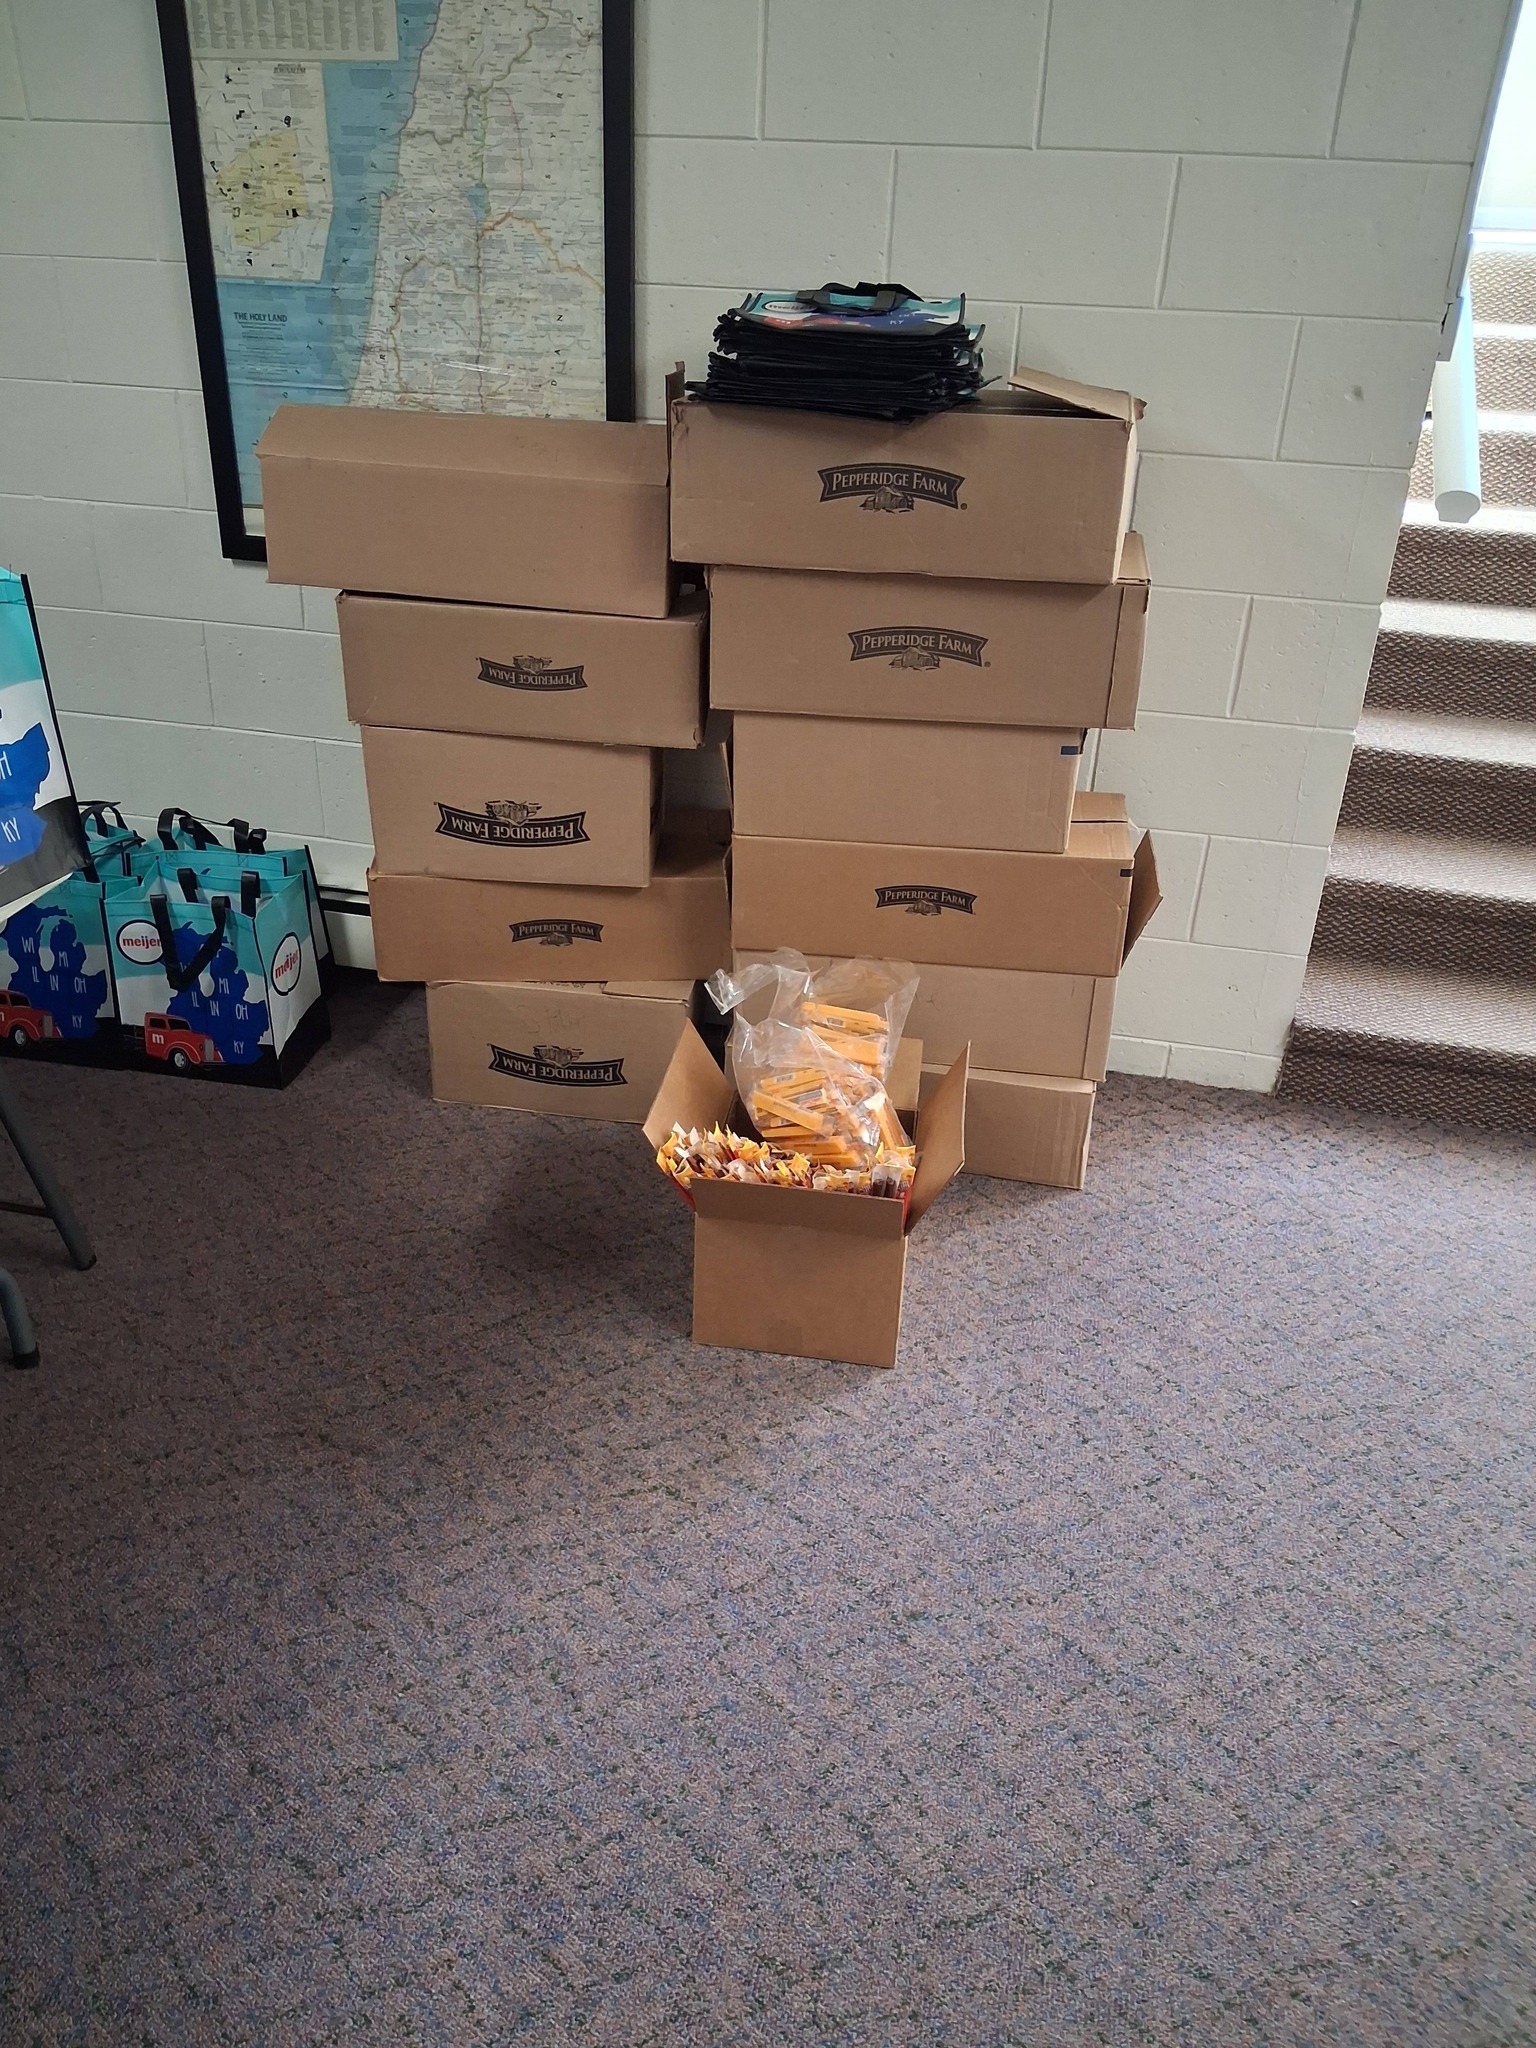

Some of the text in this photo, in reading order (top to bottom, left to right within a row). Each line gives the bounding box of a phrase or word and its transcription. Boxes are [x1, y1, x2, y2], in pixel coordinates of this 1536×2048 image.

[233, 311, 288, 322] THE HOLY LAND
[832, 472, 948, 496] PEPPERIDGE FARM
[862, 634, 973, 655] PEPPERIDGE FARM
[488, 666, 577, 686] PEPPERIDGE FARM
[0, 751, 12, 781] H
[1, 816, 21, 844] KY
[451, 816, 574, 840] PEPPERIDGE FARM
[885, 890, 966, 907] PEPPERIDGE FARM
[518, 923, 595, 937] PEPPERIDGE FARM
[21, 936, 35, 954] WI
[58, 951, 69, 968] MI
[49, 974, 59, 991] IN
[73, 976, 87, 994] OH
[218, 977, 230, 995] MI
[191, 991, 200, 1008] IL
[209, 1000, 220, 1017] IN
[235, 1003, 249, 1020] OH
[72, 1015, 82, 1029] KY
[151, 1032, 164, 1045] m
[233, 1040, 244, 1055] KY
[502, 1056, 613, 1082] PEPPERIDGE FARM
